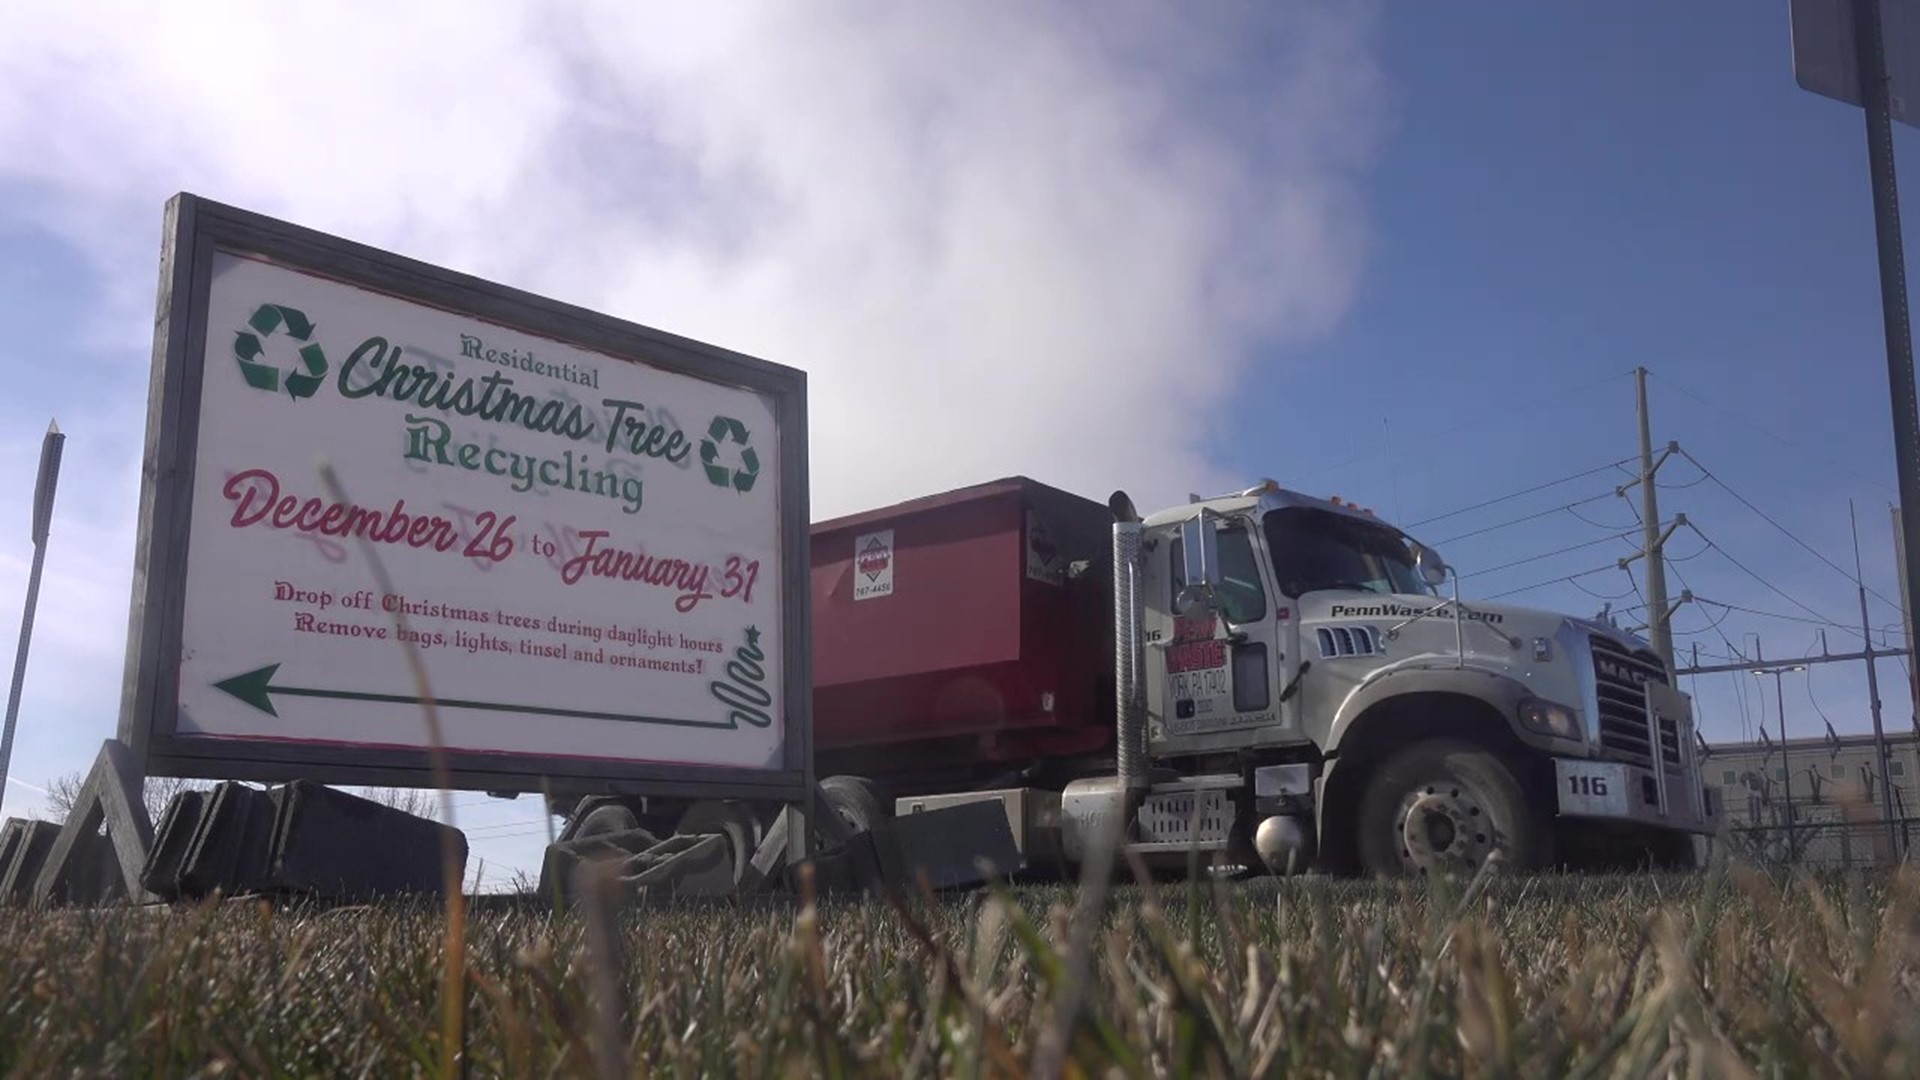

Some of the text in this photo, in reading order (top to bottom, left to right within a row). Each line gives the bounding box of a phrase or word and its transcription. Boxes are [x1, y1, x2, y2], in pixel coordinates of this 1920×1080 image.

[460, 333, 600, 389] Residential
[337, 336, 692, 463] Christmas Tree
[404, 413, 643, 514] Recycling
[223, 469, 760, 613] December 26 to January 31
[274, 581, 724, 653] Drop off Christmas trees during daylight hours
[294, 612, 704, 675] Remove bags, lights, tinsel and ornaments!
[1569, 775, 1608, 796] 116
